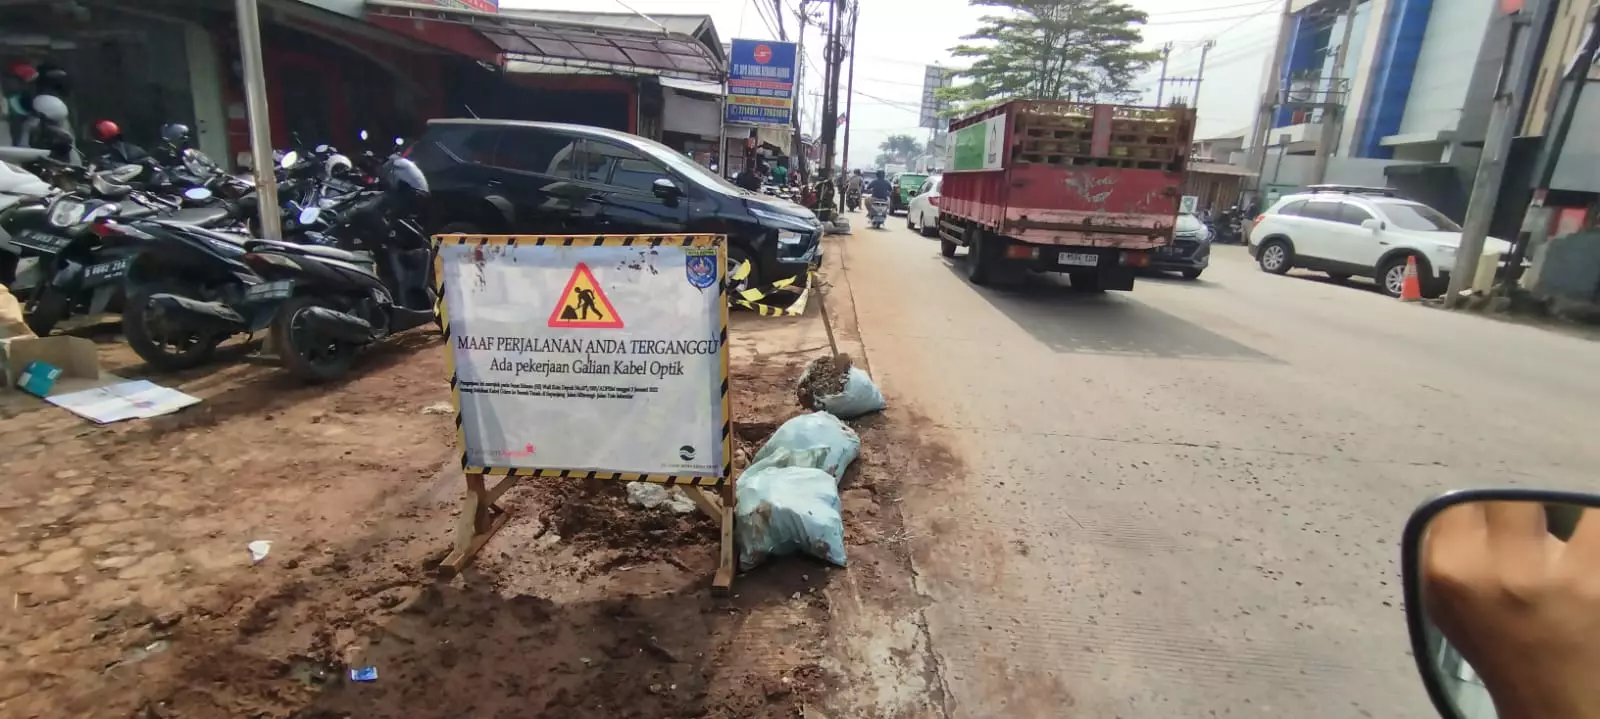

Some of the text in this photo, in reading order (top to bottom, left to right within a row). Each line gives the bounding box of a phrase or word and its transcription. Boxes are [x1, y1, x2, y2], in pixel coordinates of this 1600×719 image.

[458, 335, 720, 355] MAAF PERJALANAN ANDA TERGANGGU
[490, 357, 684, 380] Ada pekerjaan Galian Kabel Optik
